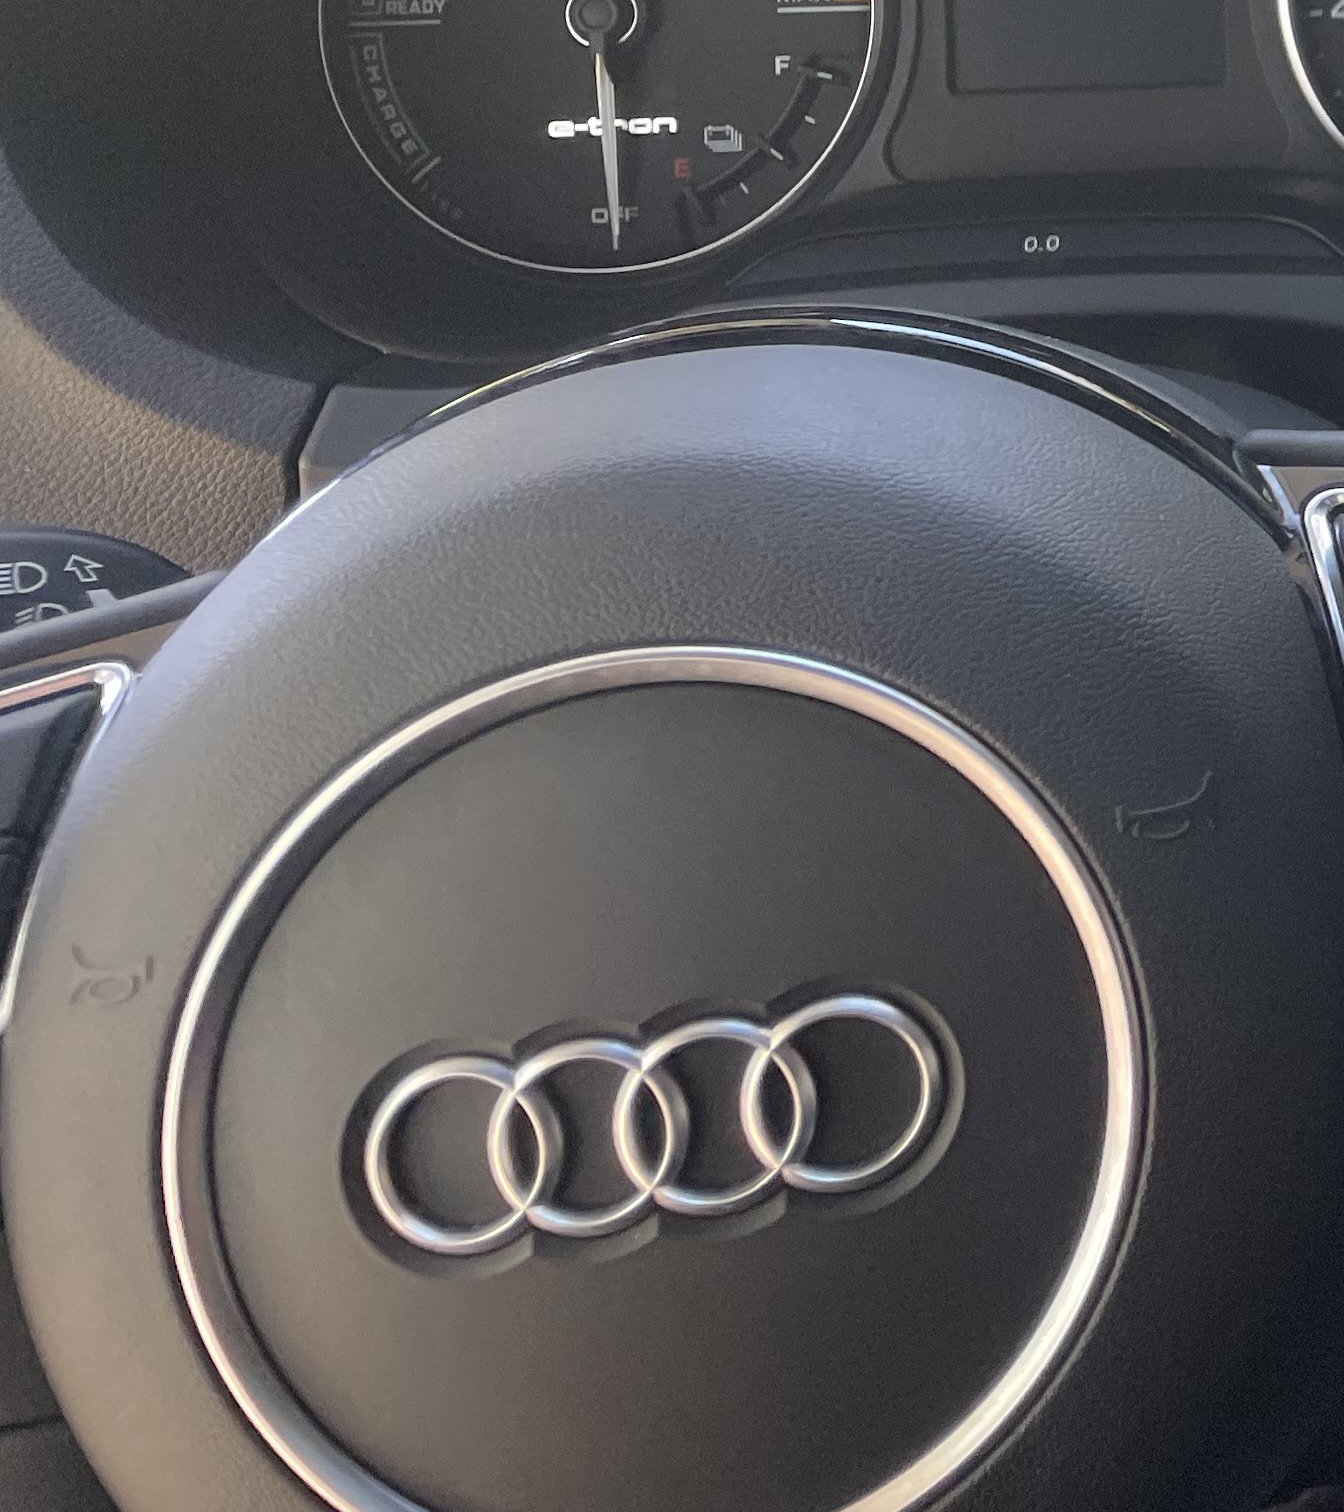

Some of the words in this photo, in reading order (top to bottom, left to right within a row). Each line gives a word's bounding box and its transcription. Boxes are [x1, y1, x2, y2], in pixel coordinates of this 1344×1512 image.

[385, 0, 446, 15] READY
[774, 54, 791, 76] F
[674, 157, 691, 179] E
[1024, 234, 1060, 254] 0.0
